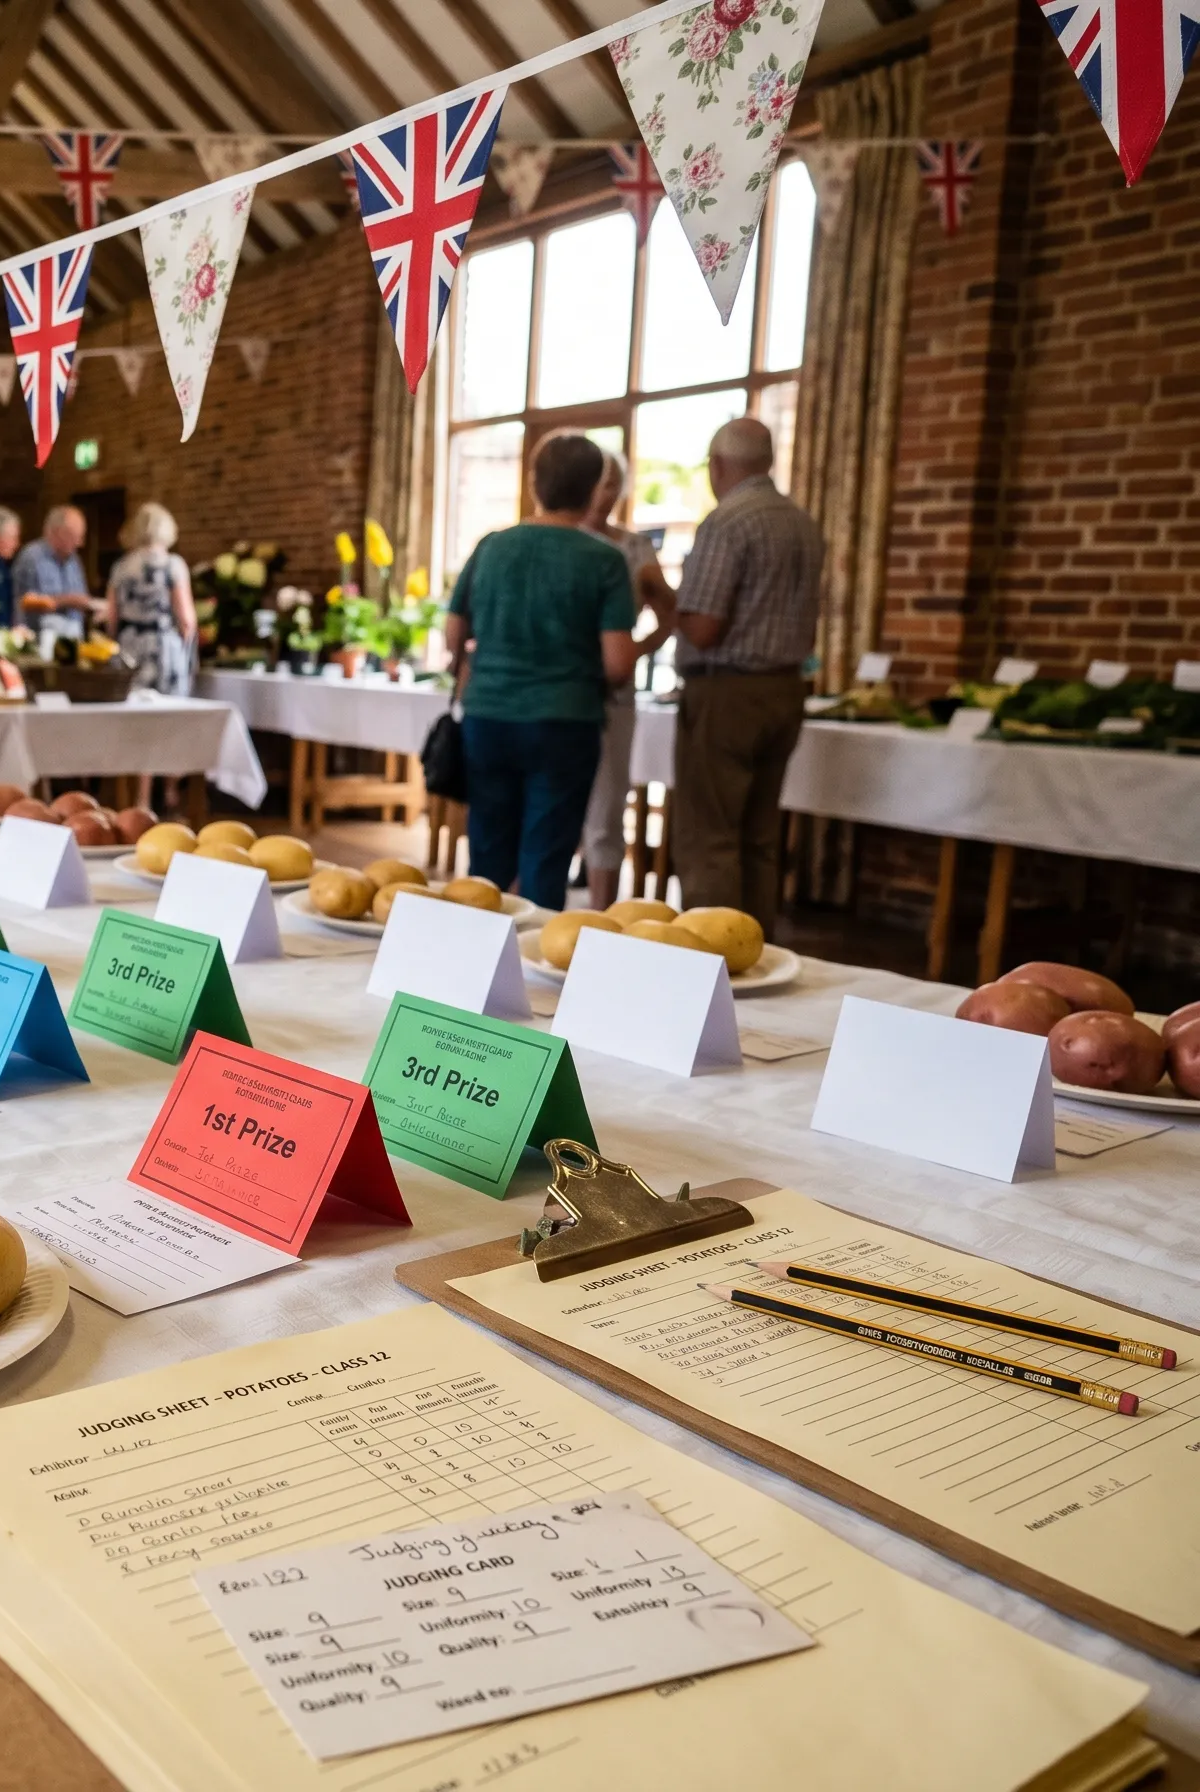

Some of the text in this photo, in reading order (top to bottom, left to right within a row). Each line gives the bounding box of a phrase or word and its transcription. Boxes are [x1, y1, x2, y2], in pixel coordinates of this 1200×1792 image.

[107, 958, 175, 994] 3rd Prize
[401, 1056, 500, 1108] 3rd Prize
[202, 1104, 298, 1158] 1st Prize
[78, 1411, 156, 1438] JUDGING
[157, 1396, 210, 1418] SHEET
[223, 1372, 309, 1400] POTATOES
[320, 1356, 368, 1376] CLASS
[369, 1351, 391, 1362] 12
[29, 1454, 90, 1476] Exhibitor
[382, 1555, 514, 1591] JUDGING CARD
[550, 1568, 588, 1582] Size:
[402, 1598, 439, 1612] Size:
[419, 1597, 541, 1633] Uniformity: 10
[248, 1626, 289, 1643] Size:
[438, 1633, 506, 1656] Quality:
[382, 1650, 411, 1671] 10
[299, 1689, 369, 1713] Quality:
